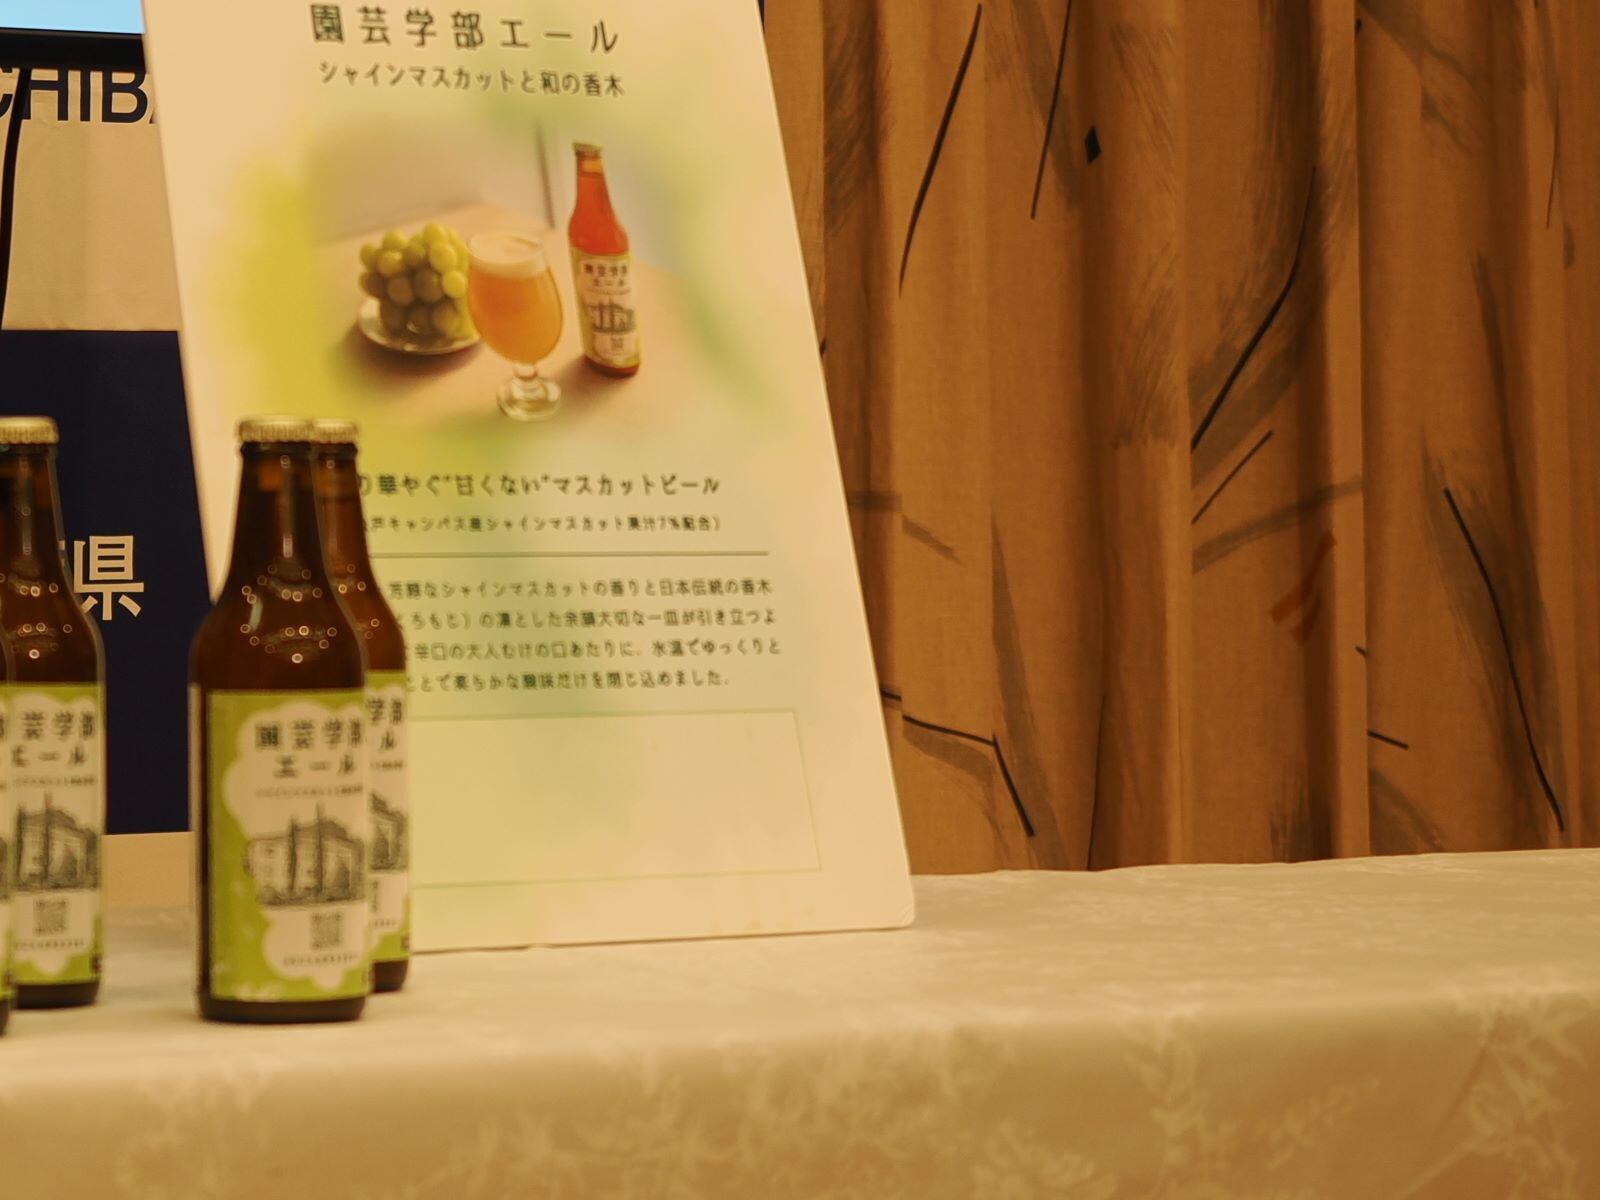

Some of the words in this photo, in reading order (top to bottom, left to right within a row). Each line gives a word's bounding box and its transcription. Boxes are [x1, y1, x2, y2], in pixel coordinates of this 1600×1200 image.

[310, 3, 619, 54] 園芸学部エール
[318, 59, 625, 98] シャインマスカットと和の香木
